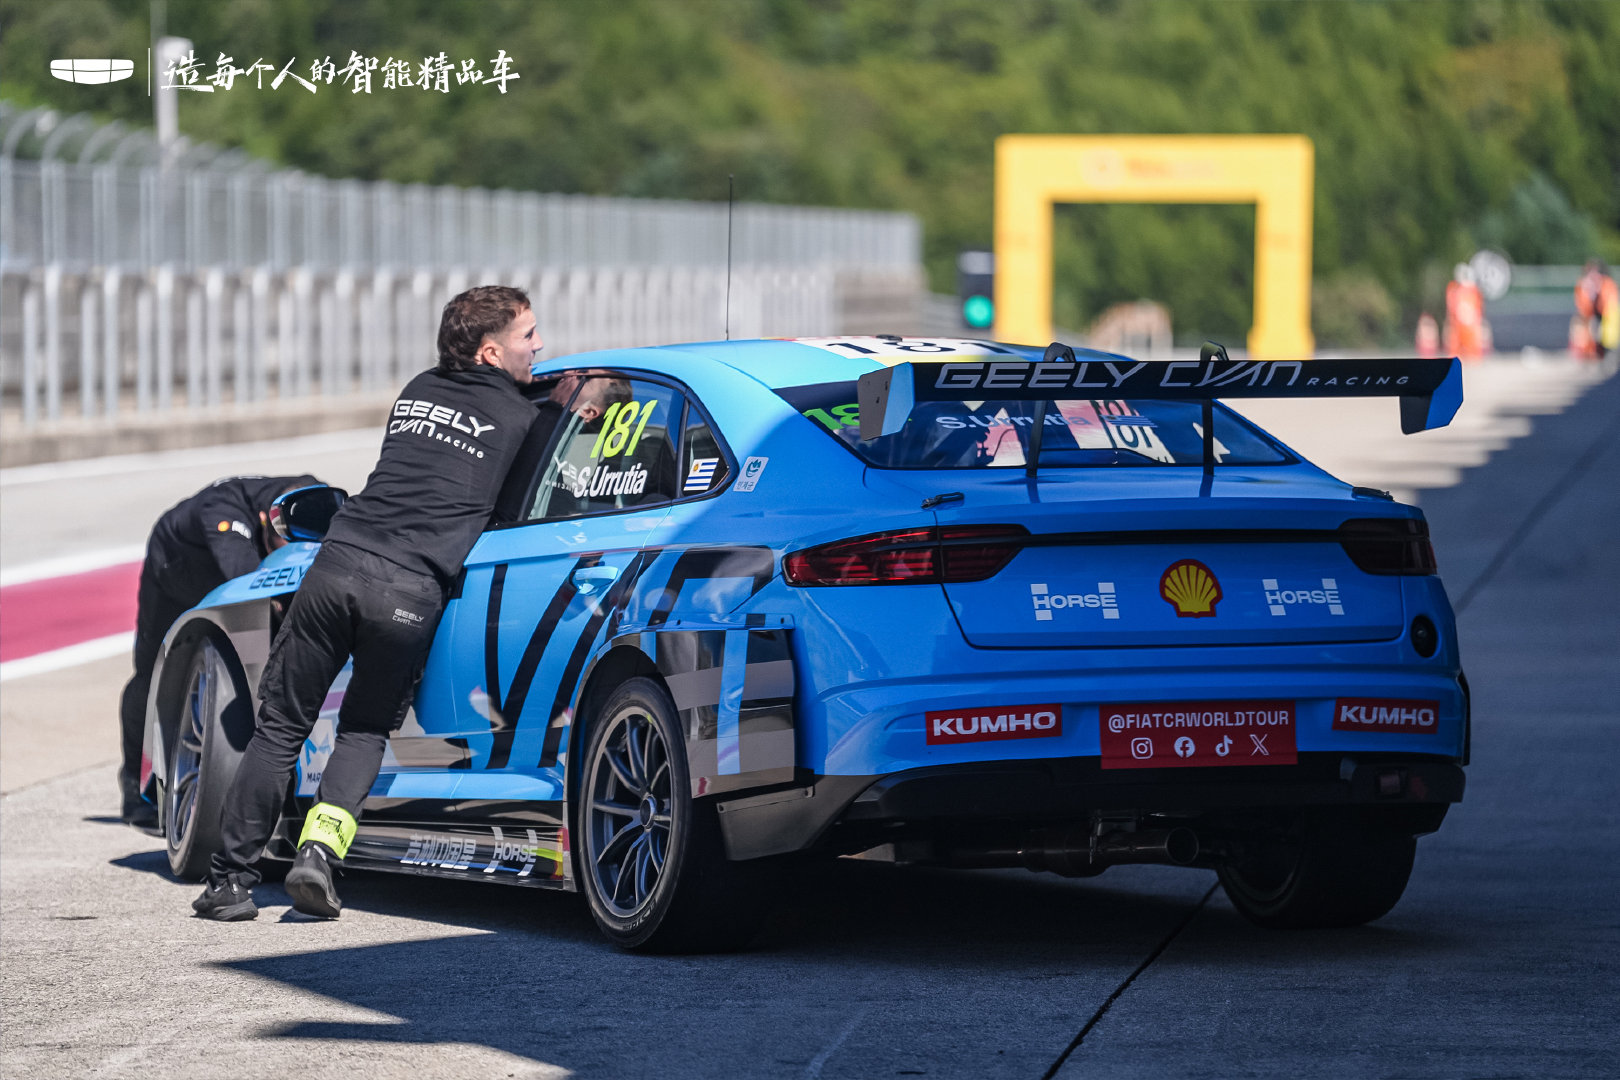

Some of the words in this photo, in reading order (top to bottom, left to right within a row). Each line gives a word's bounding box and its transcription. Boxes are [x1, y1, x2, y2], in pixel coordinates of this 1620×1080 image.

[934, 362, 1149, 388] GEELY
[1306, 376, 1409, 386] RACING
[393, 399, 496, 438] GEELY
[589, 399, 659, 459] 181
[435, 432, 485, 459] RACING
[573, 462, 649, 498] S.Urrutia
[394, 608, 424, 622] GEELY
[933, 711, 1056, 737] KUMHO
[1108, 710, 1289, 734] @FIATCRWORLDTOUR
[1340, 705, 1435, 727] KUMHO
